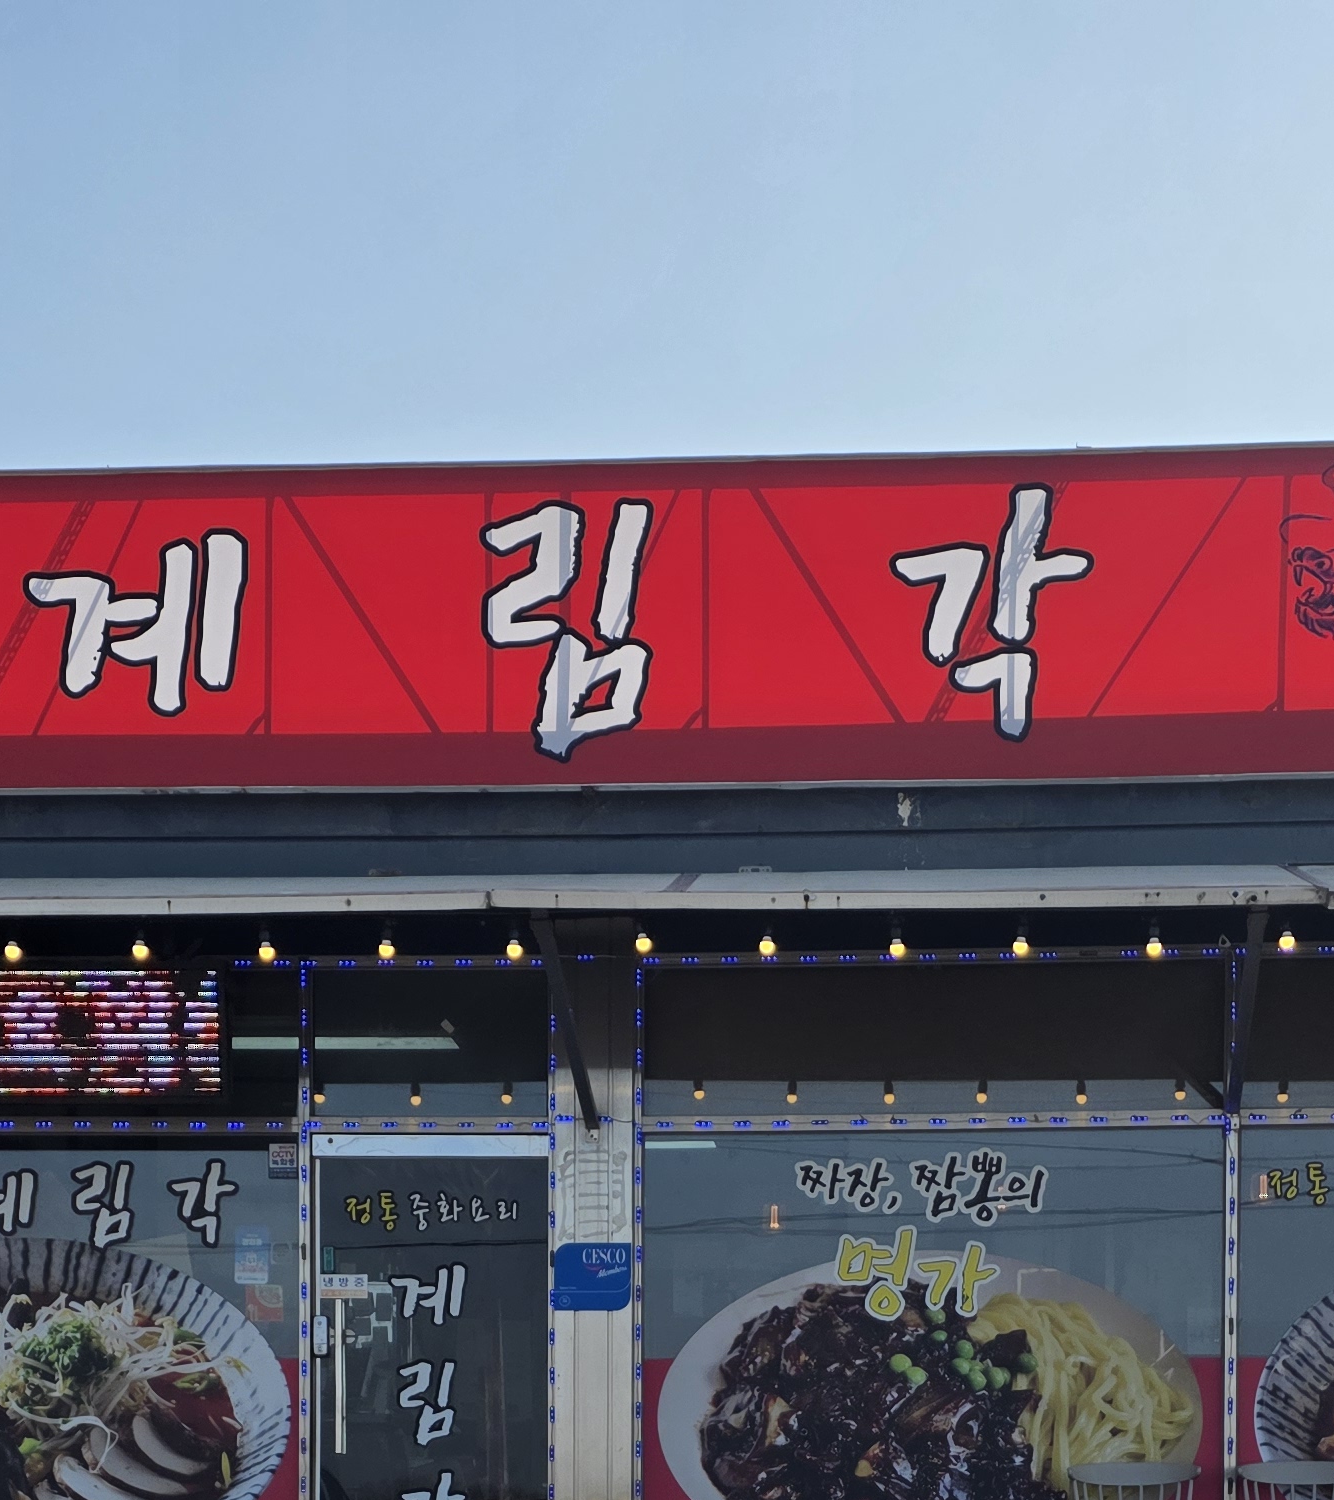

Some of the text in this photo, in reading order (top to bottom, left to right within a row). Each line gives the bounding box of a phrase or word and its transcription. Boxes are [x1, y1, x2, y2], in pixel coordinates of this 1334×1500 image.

[23, 484, 1094, 762] 계림각
[272, 1150, 295, 1158] CCTV
[796, 1148, 1048, 1225] 짜장, 짬뽕의
[1267, 1162, 1330, 1207] 정통
[346, 1192, 520, 1232] 정통 중화요리
[582, 1248, 626, 1264] CESCO
[836, 1226, 1000, 1320] 명가
